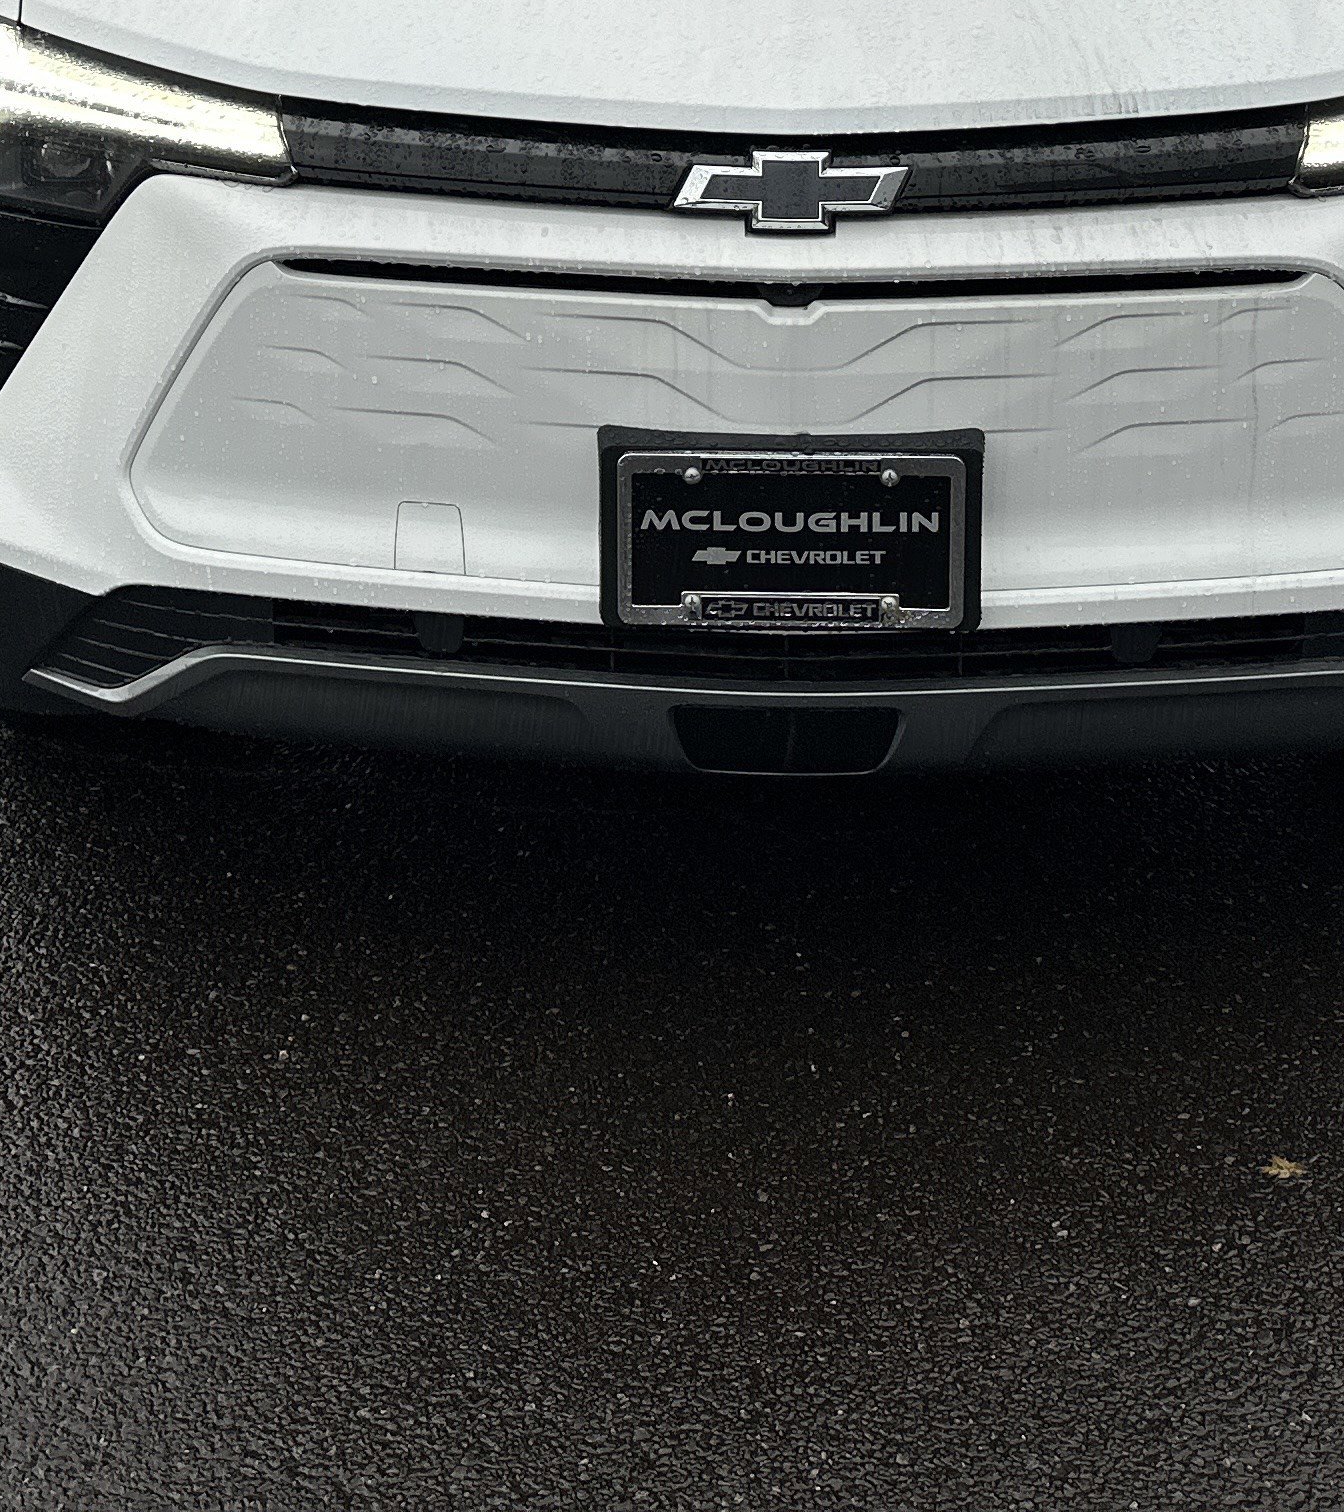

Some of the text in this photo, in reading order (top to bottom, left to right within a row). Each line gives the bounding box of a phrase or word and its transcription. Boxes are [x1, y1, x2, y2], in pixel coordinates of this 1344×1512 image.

[706, 459, 879, 472] MCLOUGHLIN
[640, 509, 939, 533] MCLOUGHLIN
[746, 550, 887, 565] CHEVROLET
[753, 602, 877, 617] CHEVROLET
